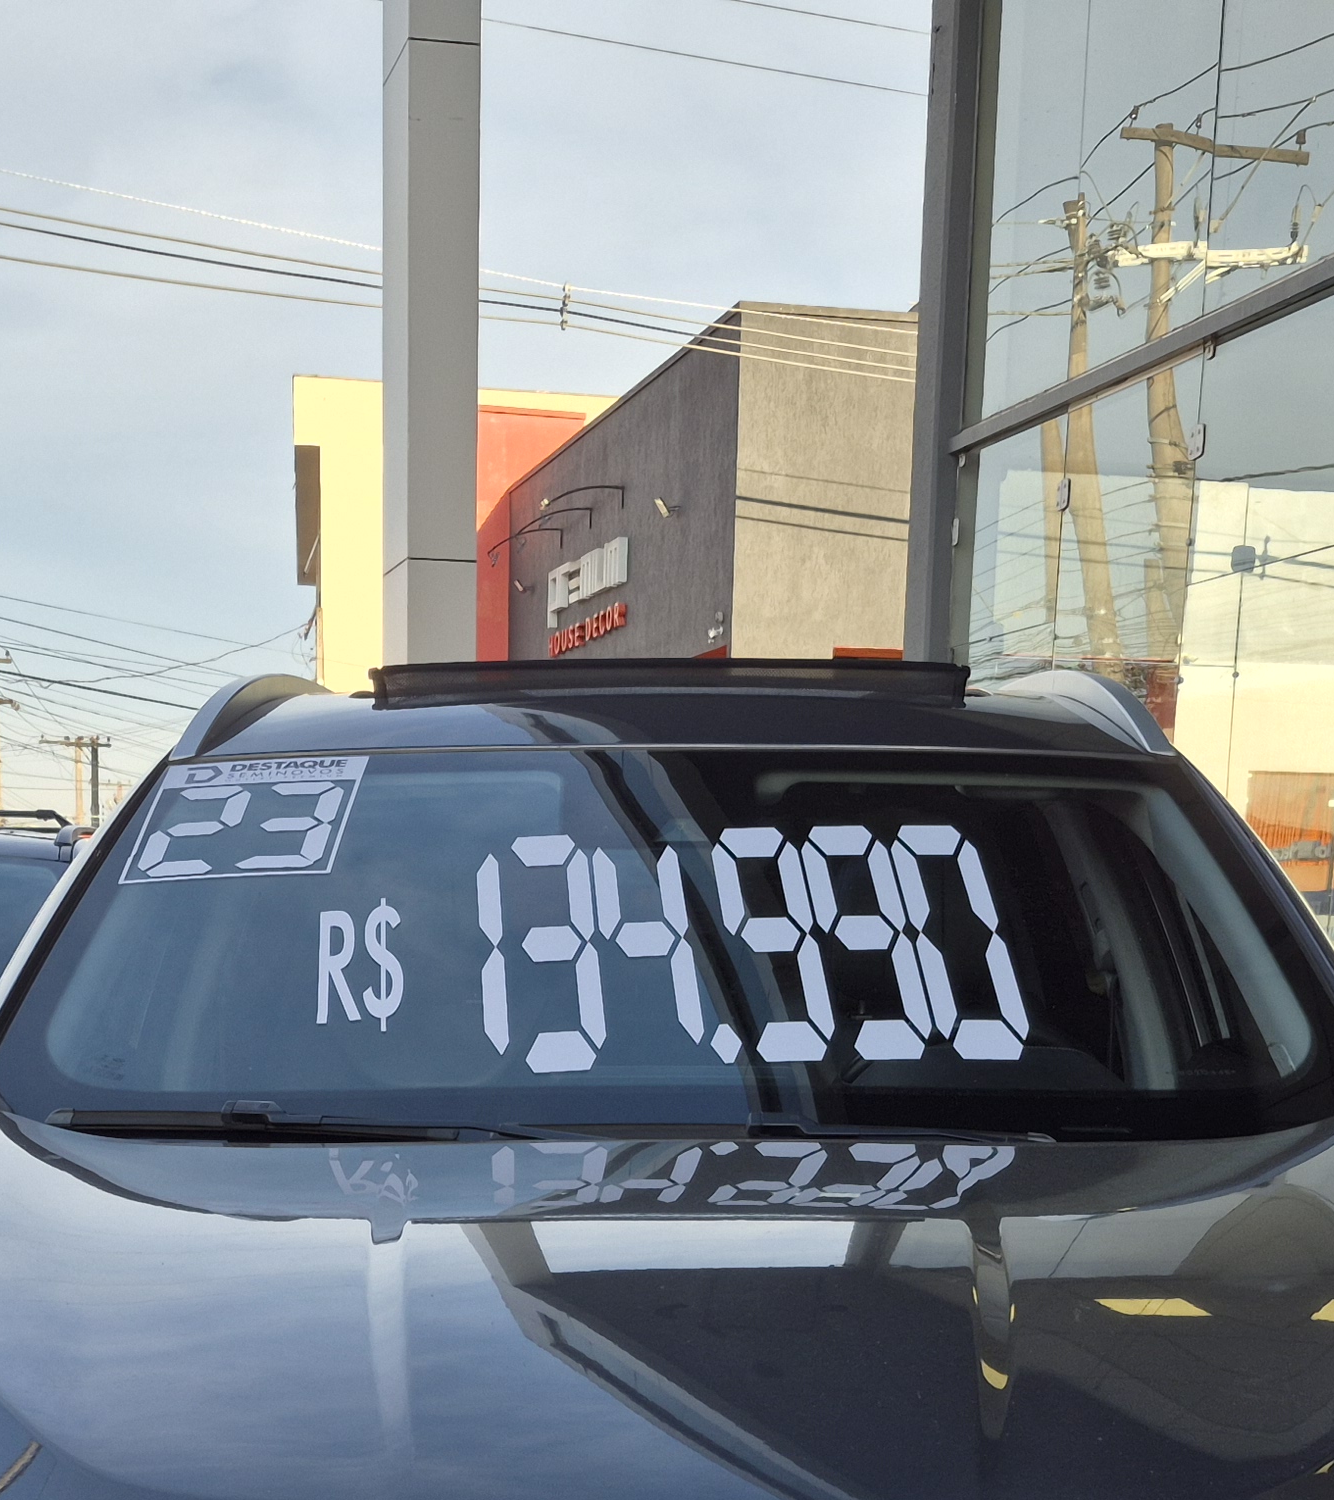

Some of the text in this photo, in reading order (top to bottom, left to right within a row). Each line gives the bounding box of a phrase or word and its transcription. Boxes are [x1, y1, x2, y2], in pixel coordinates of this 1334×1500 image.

[549, 602, 624, 657] HOUSE DECOR
[227, 768, 344, 779] SEMINOVOS
[230, 759, 349, 772] DESTAQUE
[137, 781, 344, 878] 23
[315, 824, 1030, 1073] R$ 134.990
